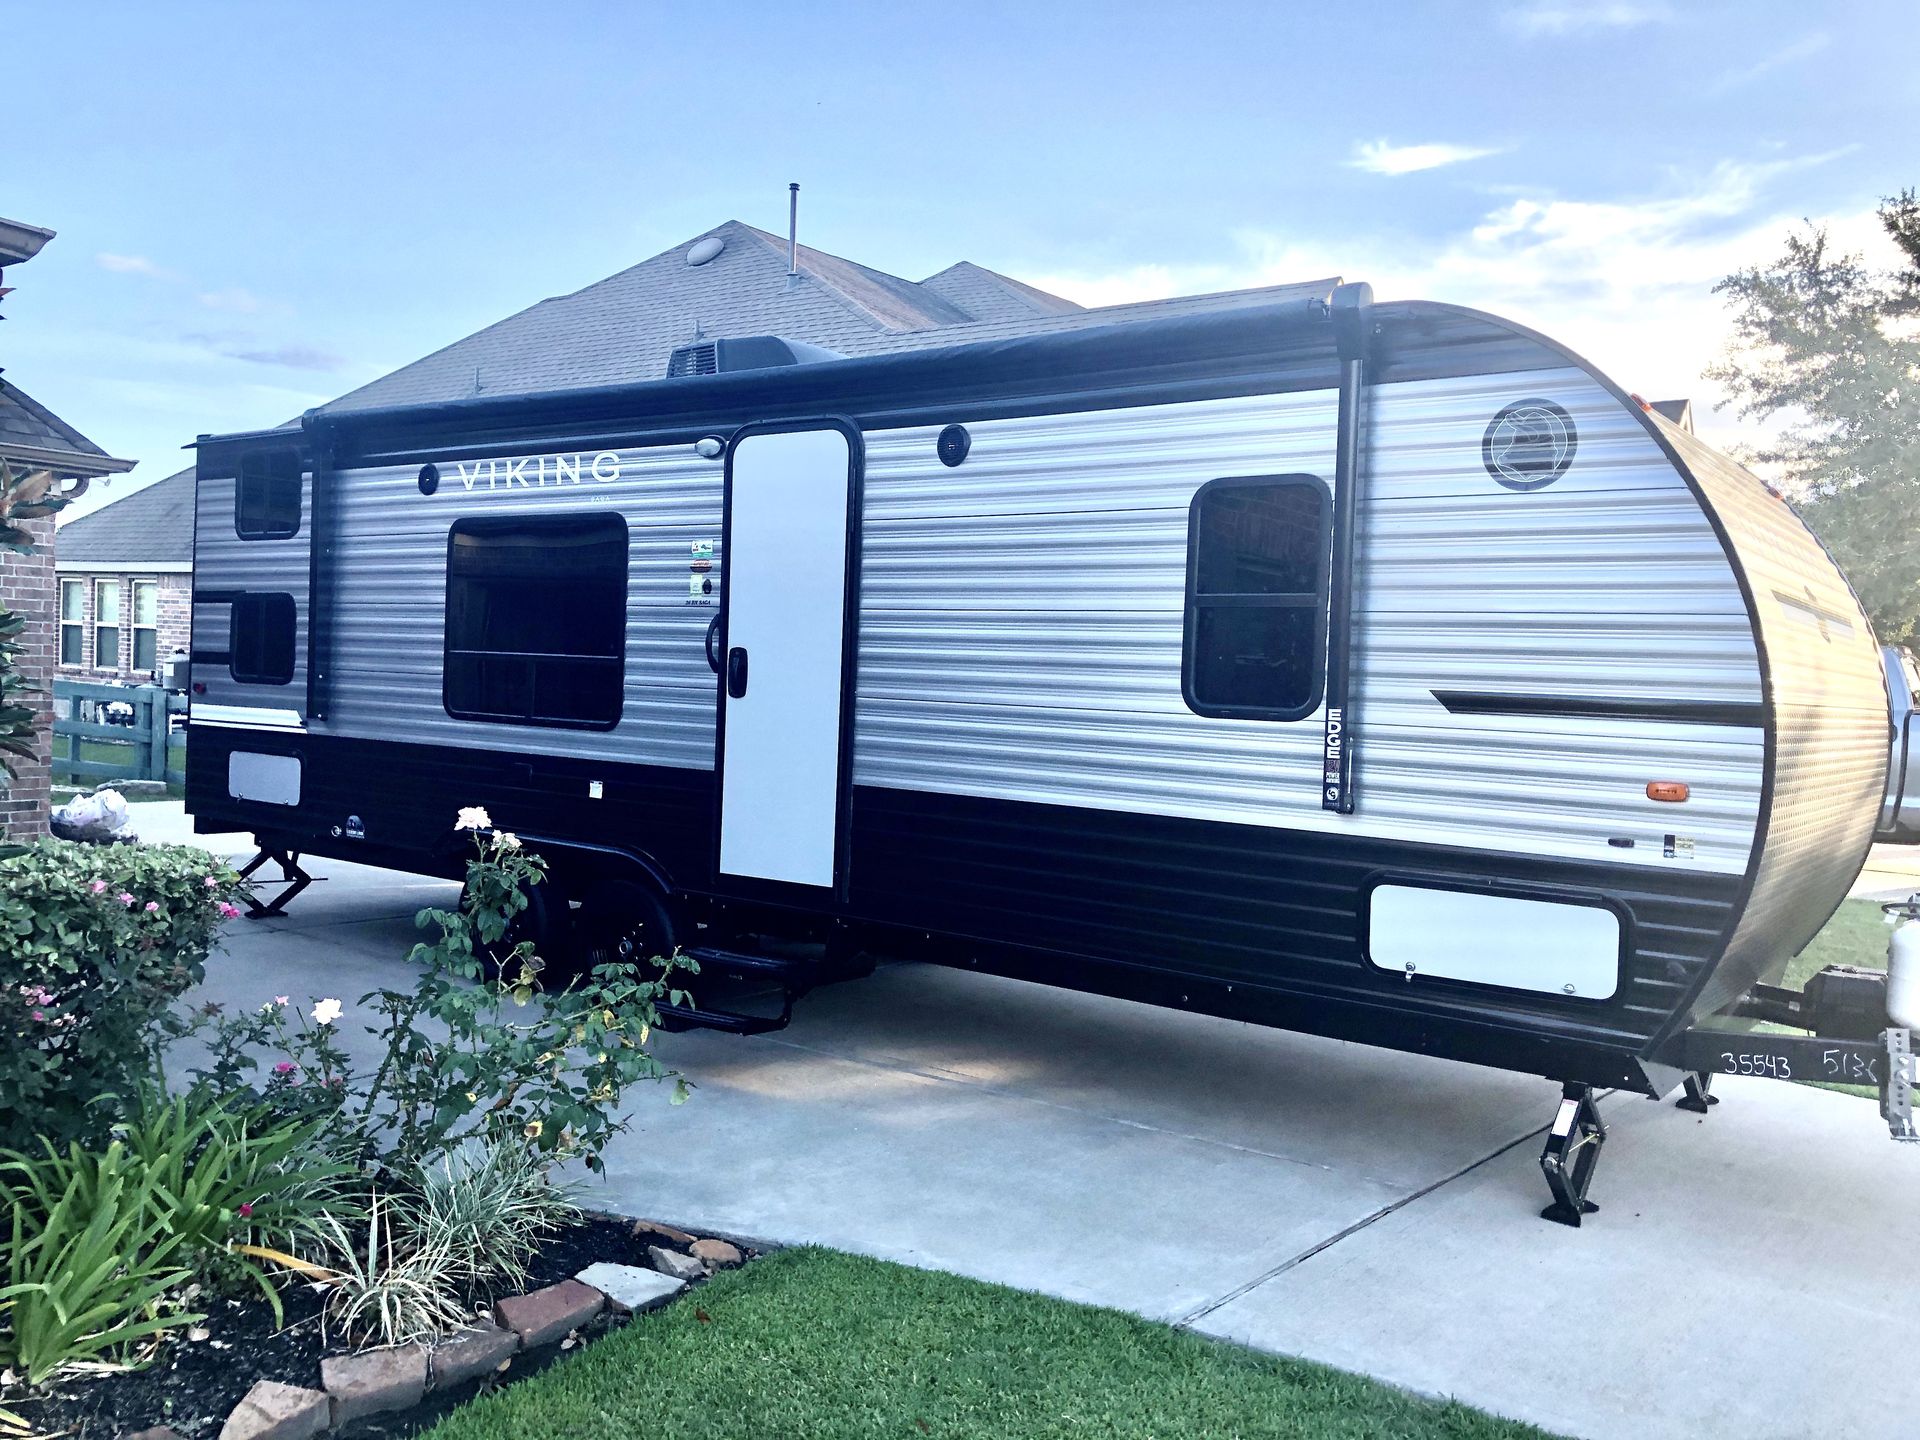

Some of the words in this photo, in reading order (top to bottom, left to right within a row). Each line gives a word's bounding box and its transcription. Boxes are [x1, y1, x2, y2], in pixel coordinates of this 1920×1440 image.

[457, 452, 622, 491] VIKING
[1326, 708, 1342, 759] EDGE
[1721, 1052, 1792, 1079] 35543
